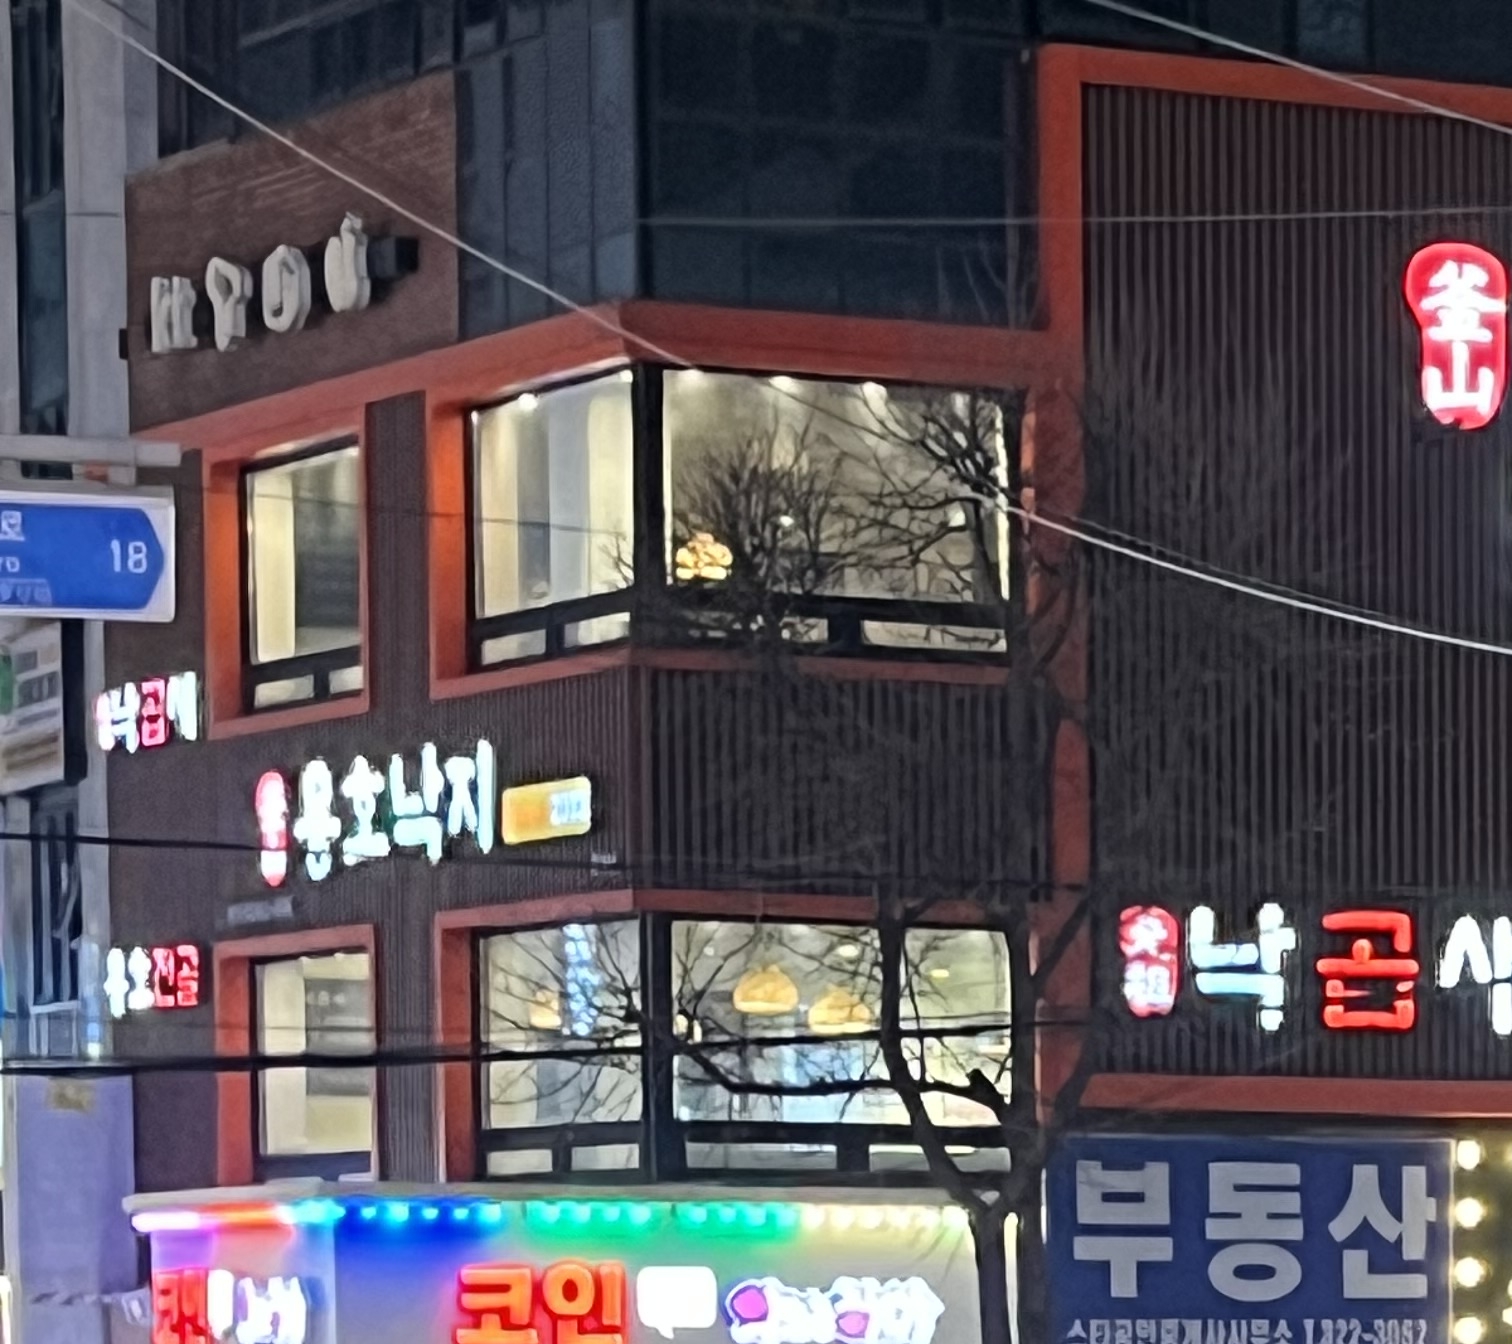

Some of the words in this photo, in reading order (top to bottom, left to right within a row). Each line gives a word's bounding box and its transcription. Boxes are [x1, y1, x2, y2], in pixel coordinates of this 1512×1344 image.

[1420, 260, 1506, 415] 釜山
[110, 539, 148, 574] 18
[1072, 1161, 1437, 1302] 부동산
